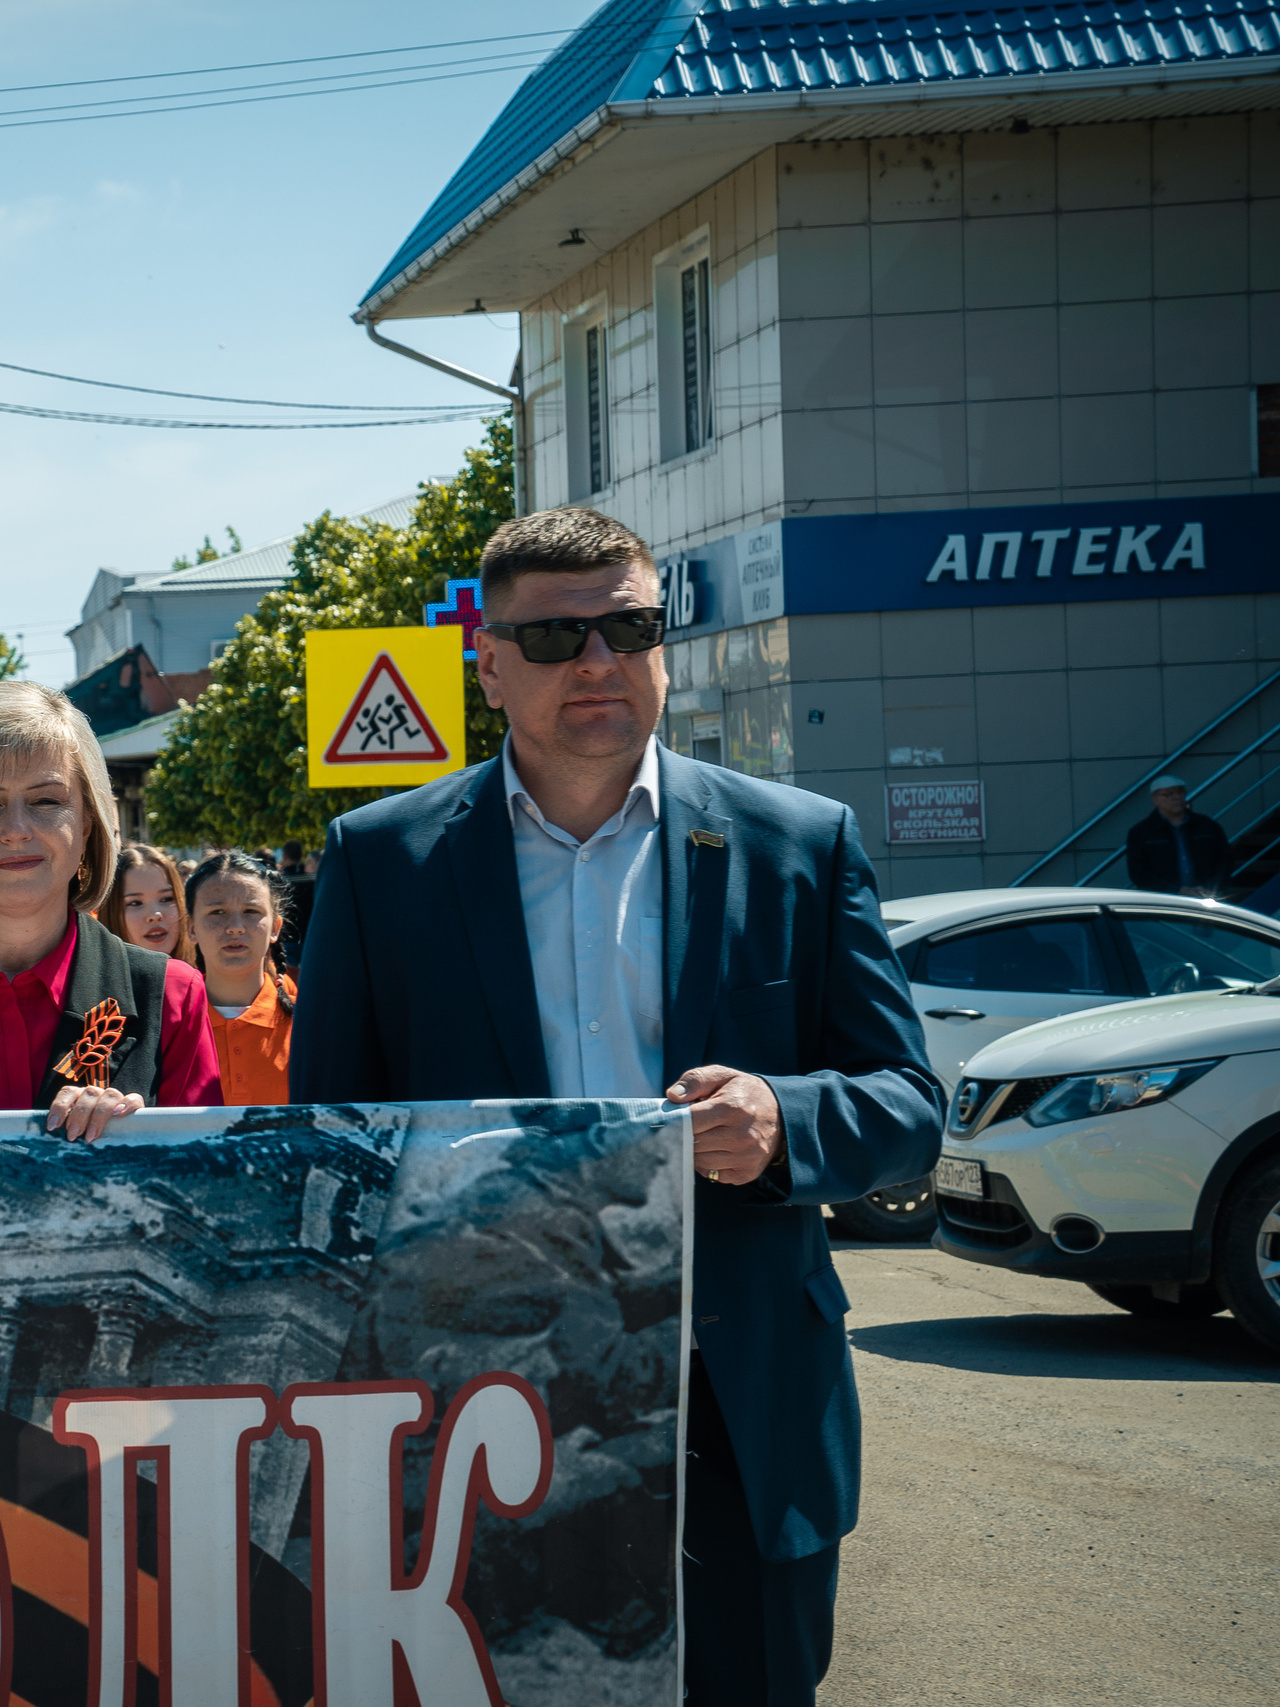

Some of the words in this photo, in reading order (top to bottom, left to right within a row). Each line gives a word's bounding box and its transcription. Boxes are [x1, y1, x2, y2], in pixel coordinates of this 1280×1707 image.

[926, 522, 1206, 582] АПТЕКА
[892, 785, 979, 807] ОСТОРОЖНО!
[908, 808, 963, 818] КРУТАЯ
[893, 817, 979, 830] СКОЛЬЗКАЯ
[899, 828, 978, 839] ЛЕСТНИЦА
